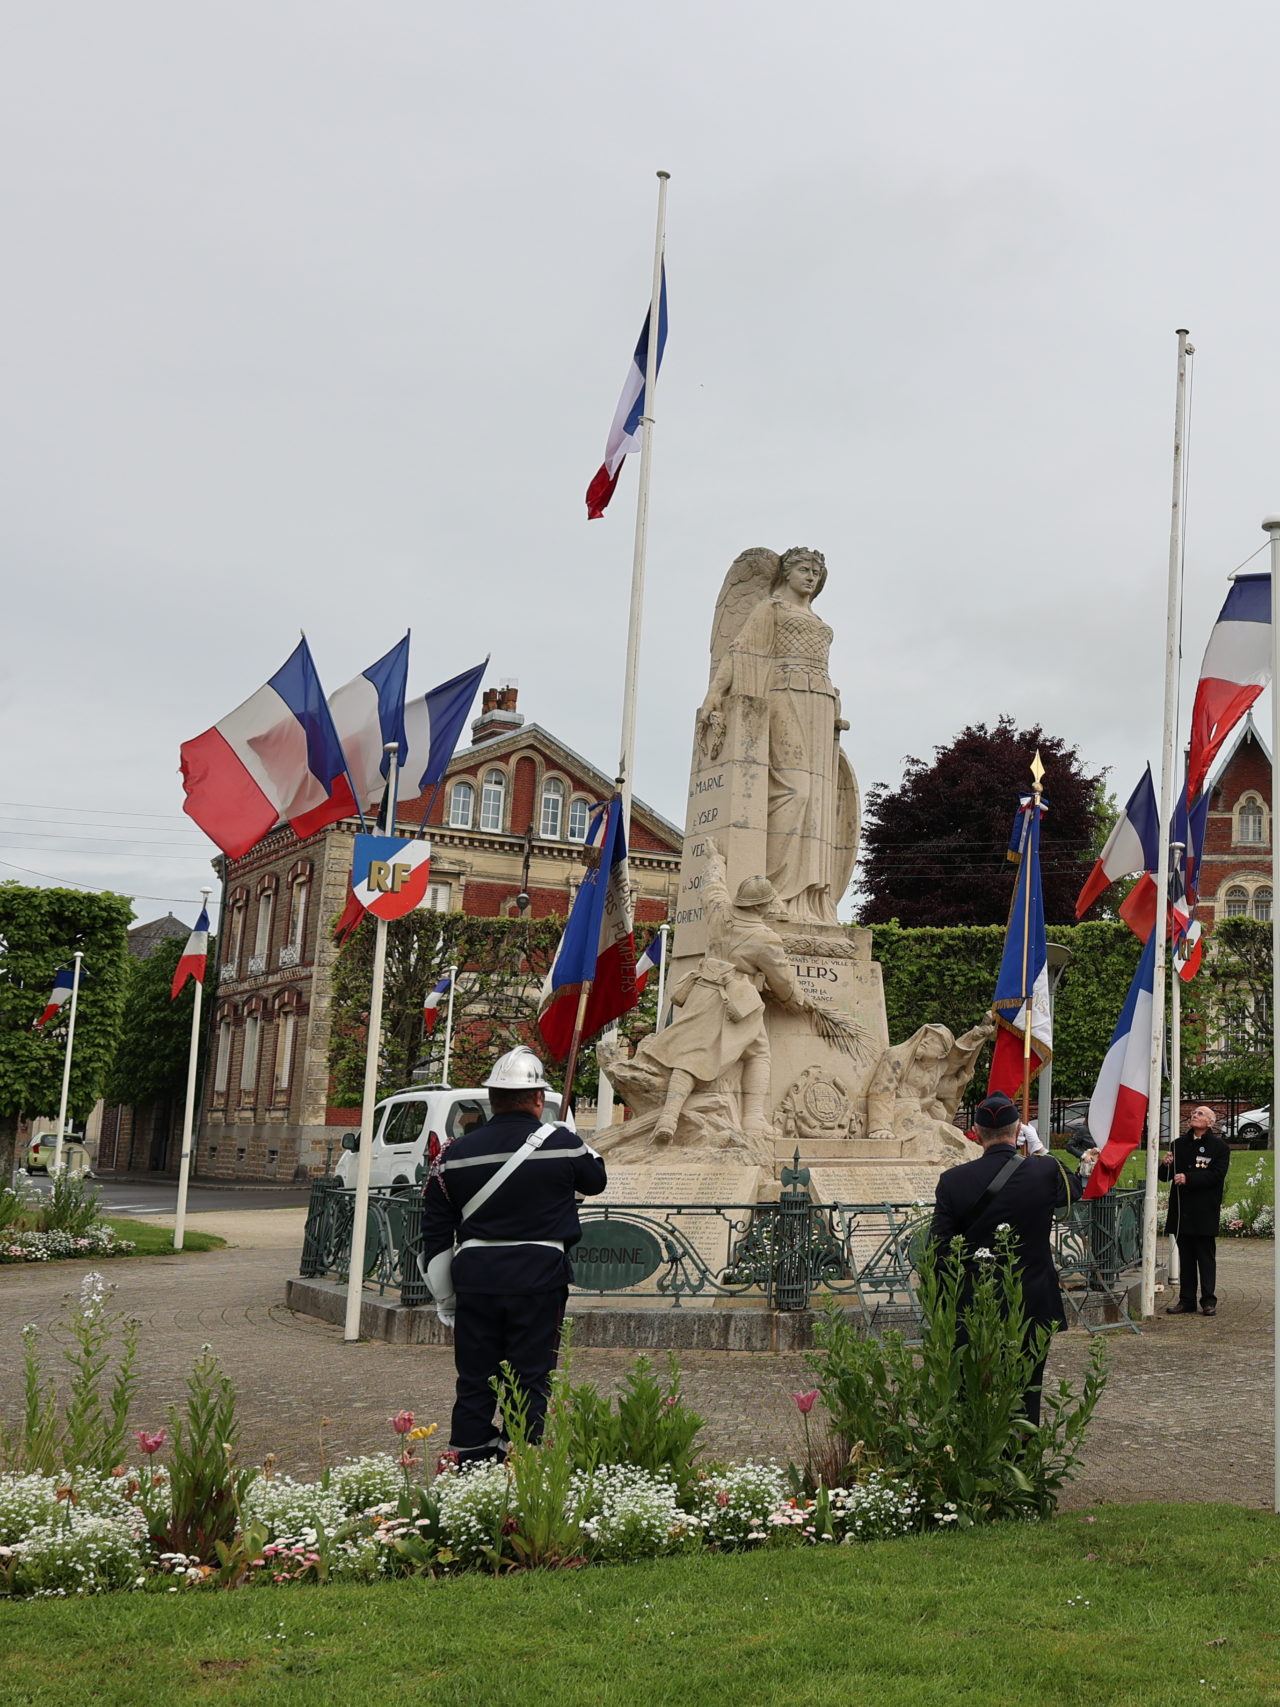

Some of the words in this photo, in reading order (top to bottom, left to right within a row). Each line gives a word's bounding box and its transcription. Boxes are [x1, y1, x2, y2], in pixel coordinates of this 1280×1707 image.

[695, 774, 725, 794] MARNE
[691, 843, 705, 857] VER
[366, 860, 412, 893] RF
[676, 907, 703, 924] ORIENT
[611, 920, 637, 994] POMPIERS
[1177, 937, 1195, 961] RF
[790, 965, 839, 983] LERS
